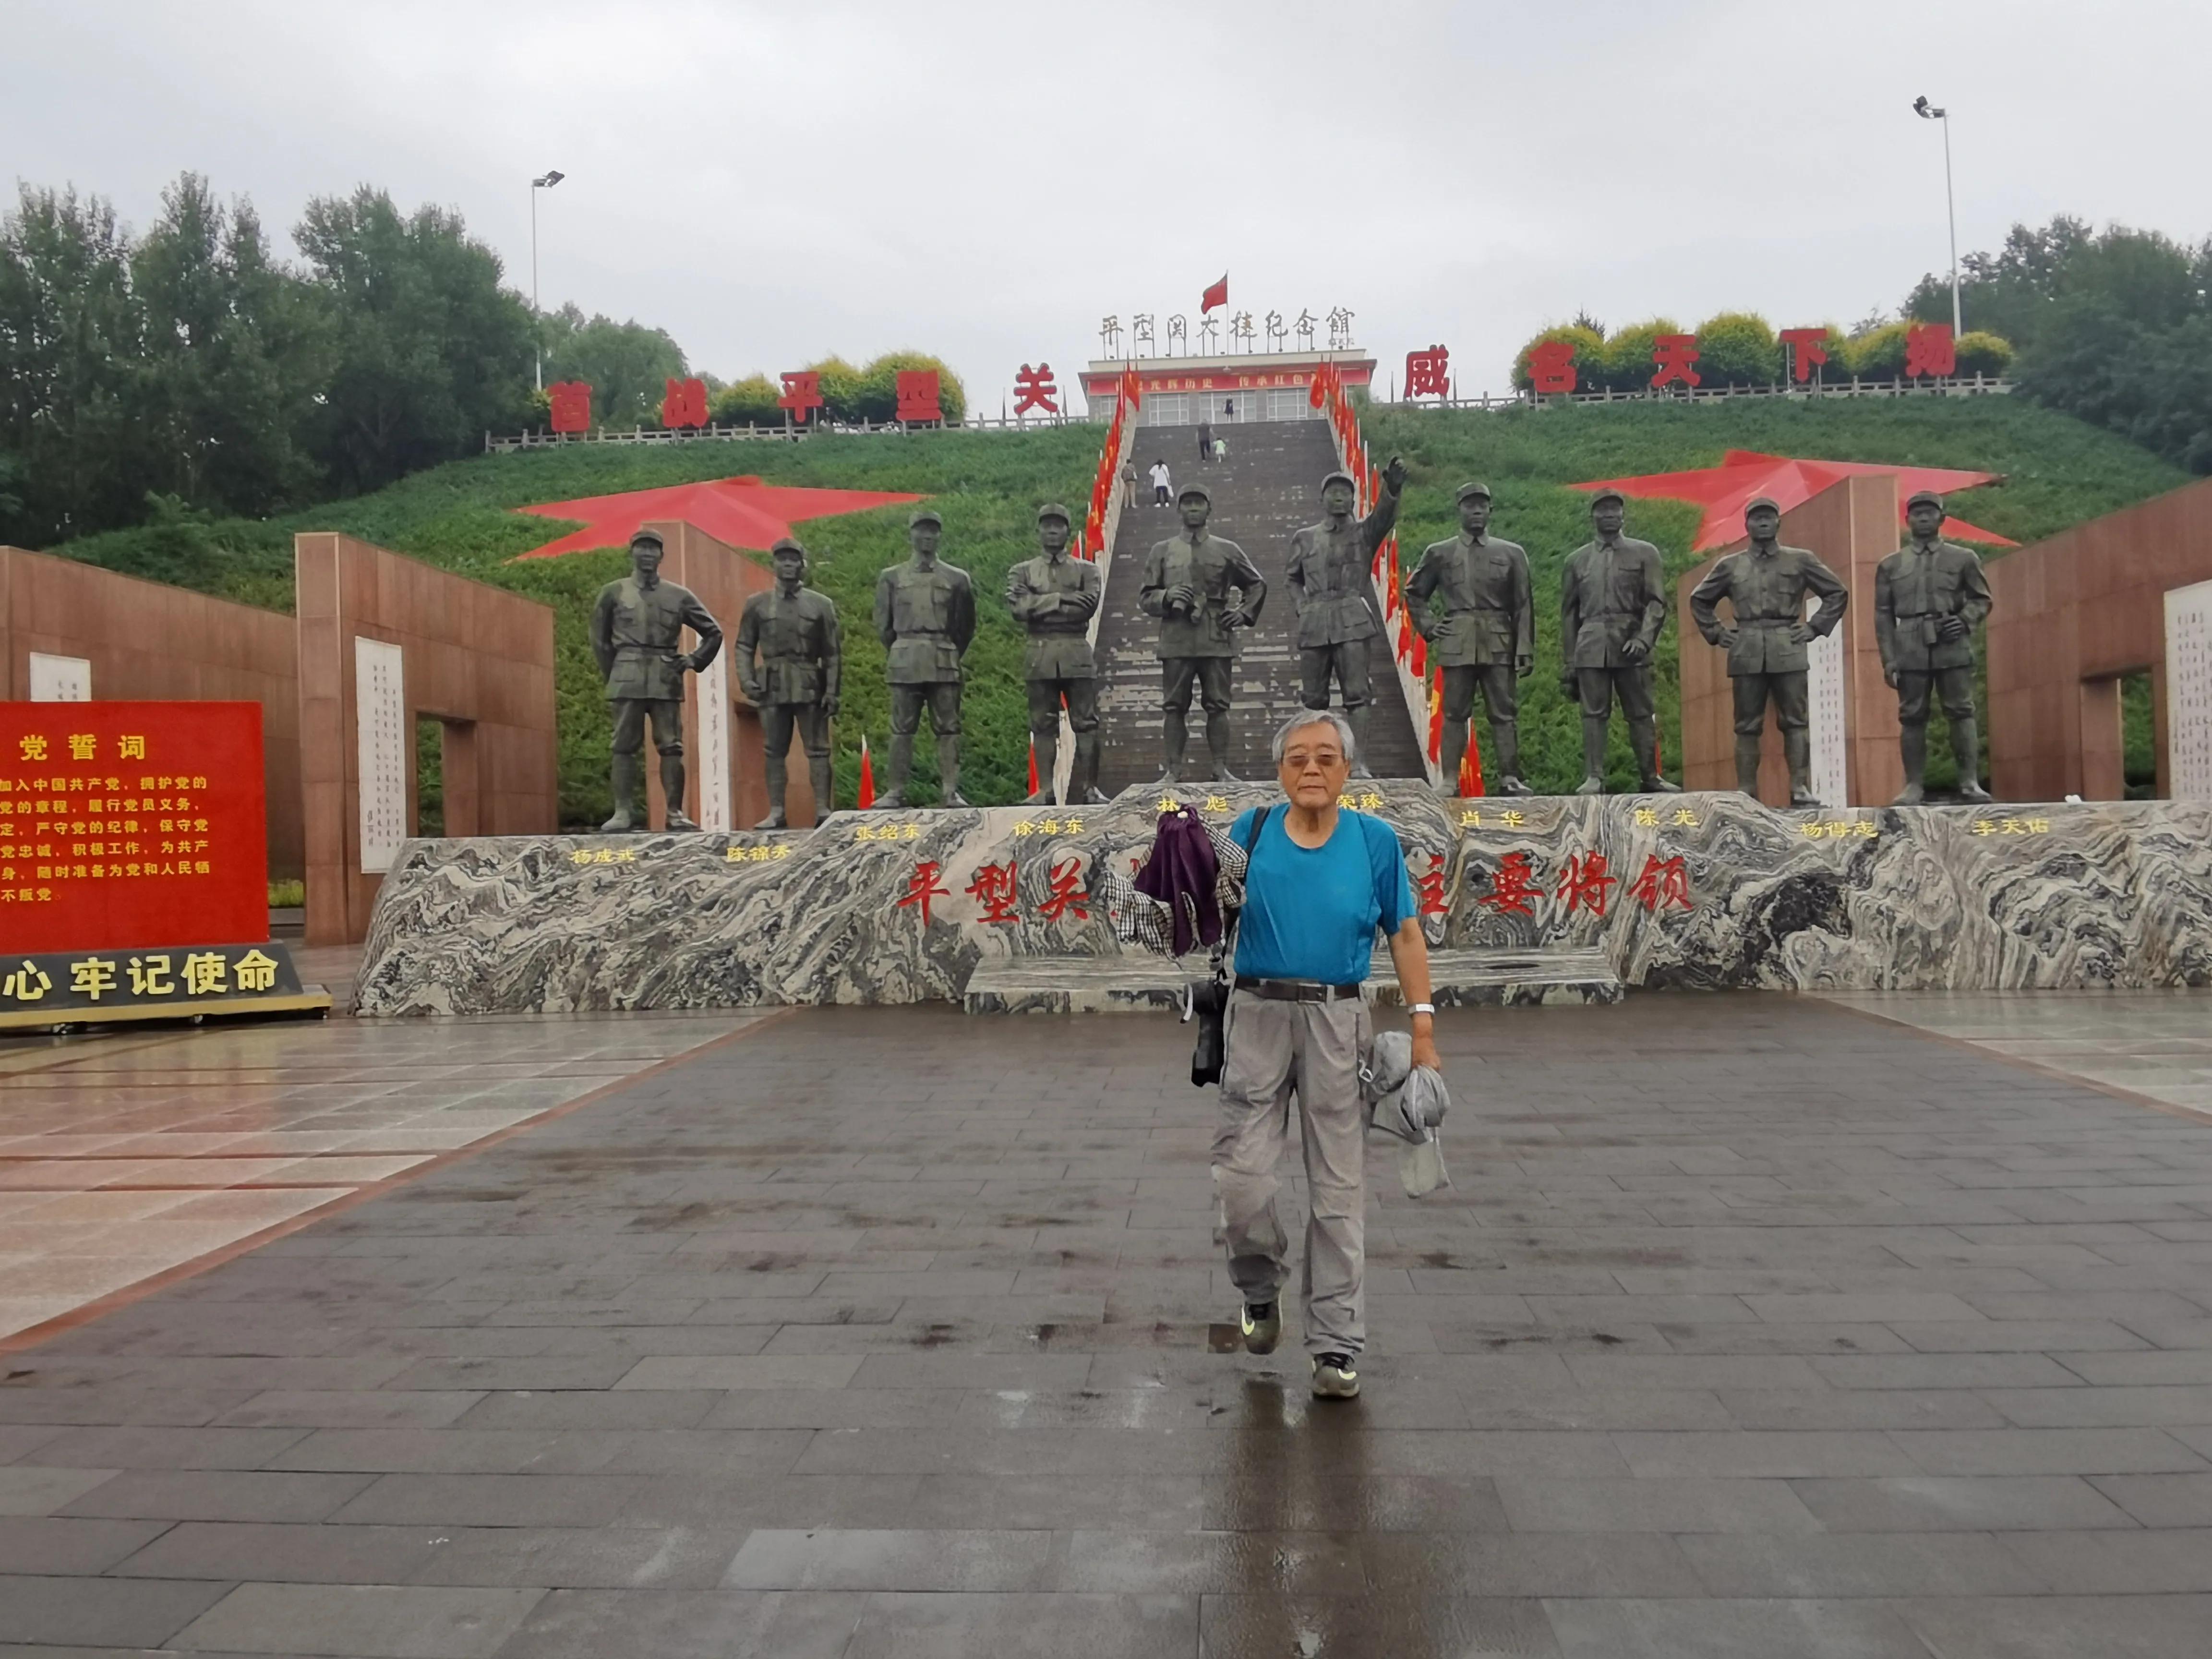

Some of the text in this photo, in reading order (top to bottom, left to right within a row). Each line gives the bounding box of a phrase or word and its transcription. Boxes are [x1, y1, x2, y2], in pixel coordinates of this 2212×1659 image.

[1115, 377, 1213, 392] 光辉历史
[19, 734, 145, 761] 党誓词
[1157, 796, 1228, 814] 林彪
[1458, 809, 1525, 828] 肖华
[1635, 808, 1699, 827] 陈光
[855, 824, 921, 841] 张绍东
[1013, 818, 1085, 836] 徐海东
[1800, 821, 1879, 839] 杨得志
[1972, 818, 2050, 836] 李天佑
[570, 849, 636, 864] 杨成武
[726, 845, 791, 862] 陈锦秀
[897, 850, 1694, 926] 平型关 主要将领
